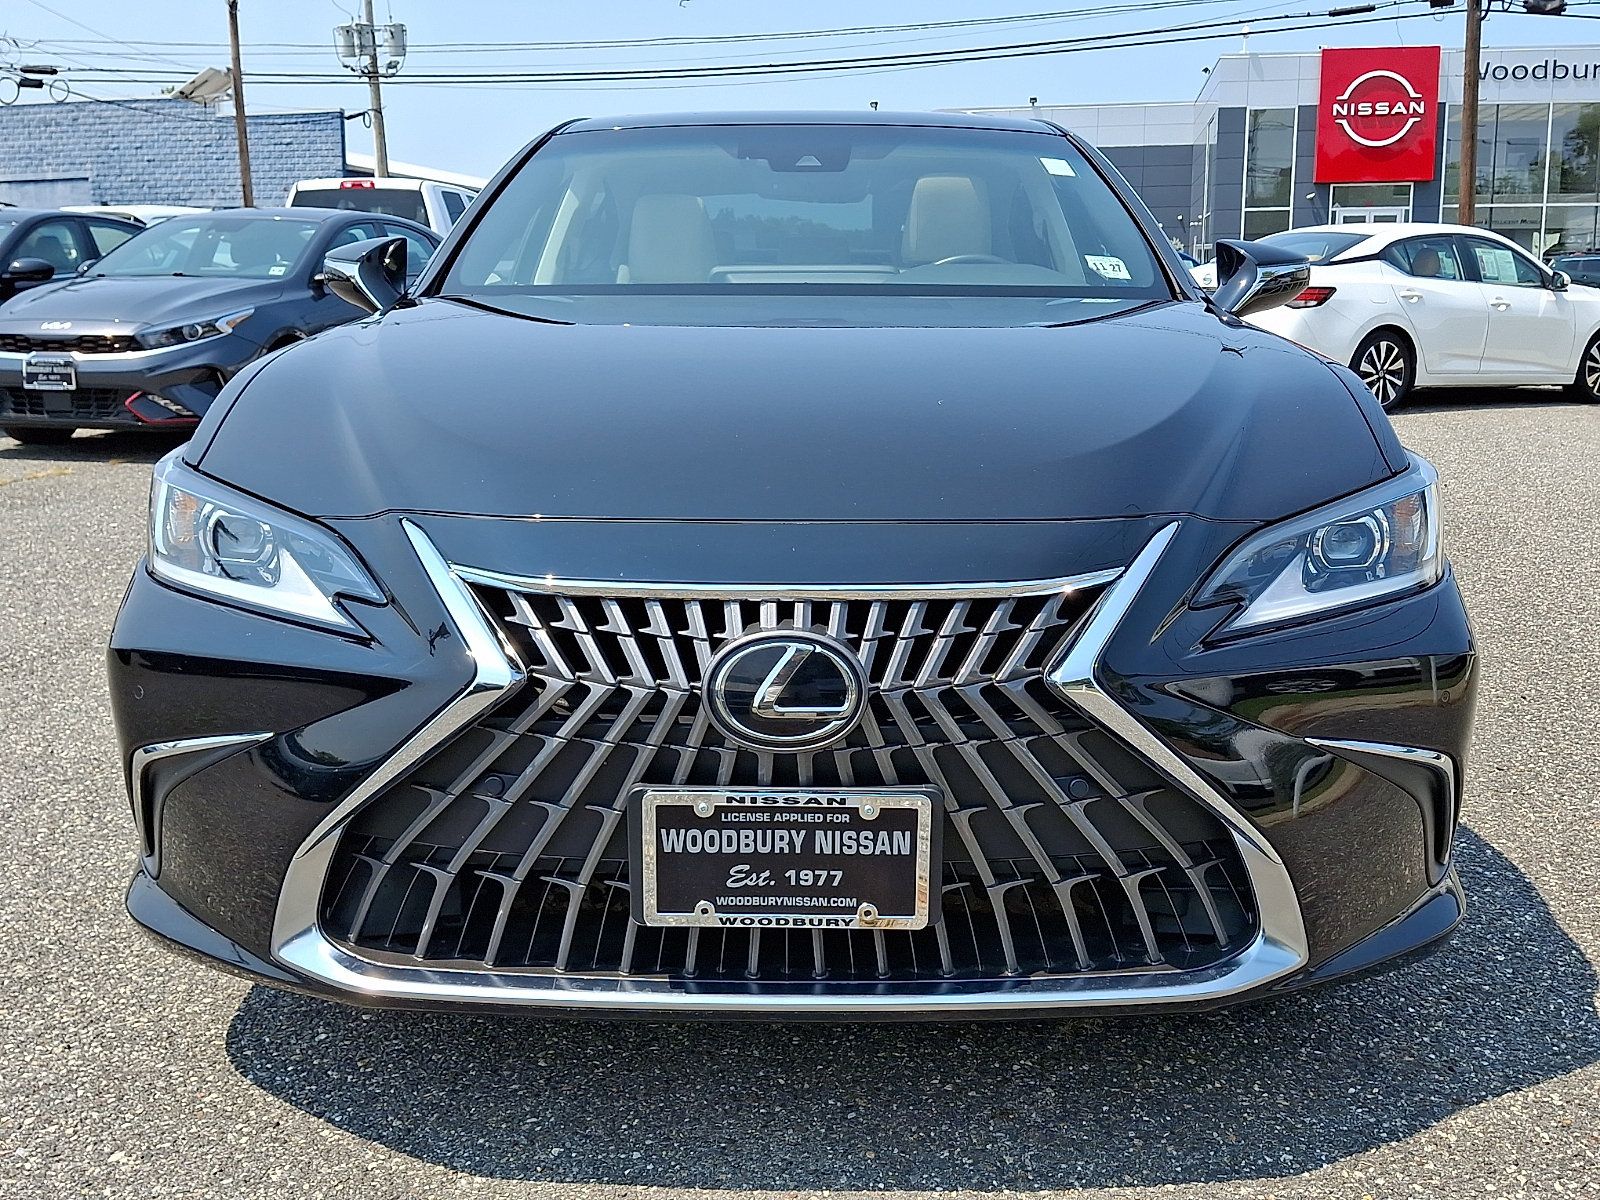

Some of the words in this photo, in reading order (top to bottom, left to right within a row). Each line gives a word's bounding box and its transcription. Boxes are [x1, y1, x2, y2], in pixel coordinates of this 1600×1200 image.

[1332, 100, 1425, 117] NISSAN
[726, 796, 847, 806] NISSAN
[721, 812, 771, 823] LICENSE
[774, 813, 823, 823] APPLIED
[827, 813, 850, 824] FOR
[660, 828, 806, 854] WOODBURY
[815, 830, 911, 855] NISSAN
[726, 864, 776, 888] Est.
[784, 869, 843, 886] 1977
[716, 896, 857, 908] WOODBURYNISSAN.COM
[719, 917, 855, 927] WOODBURY
